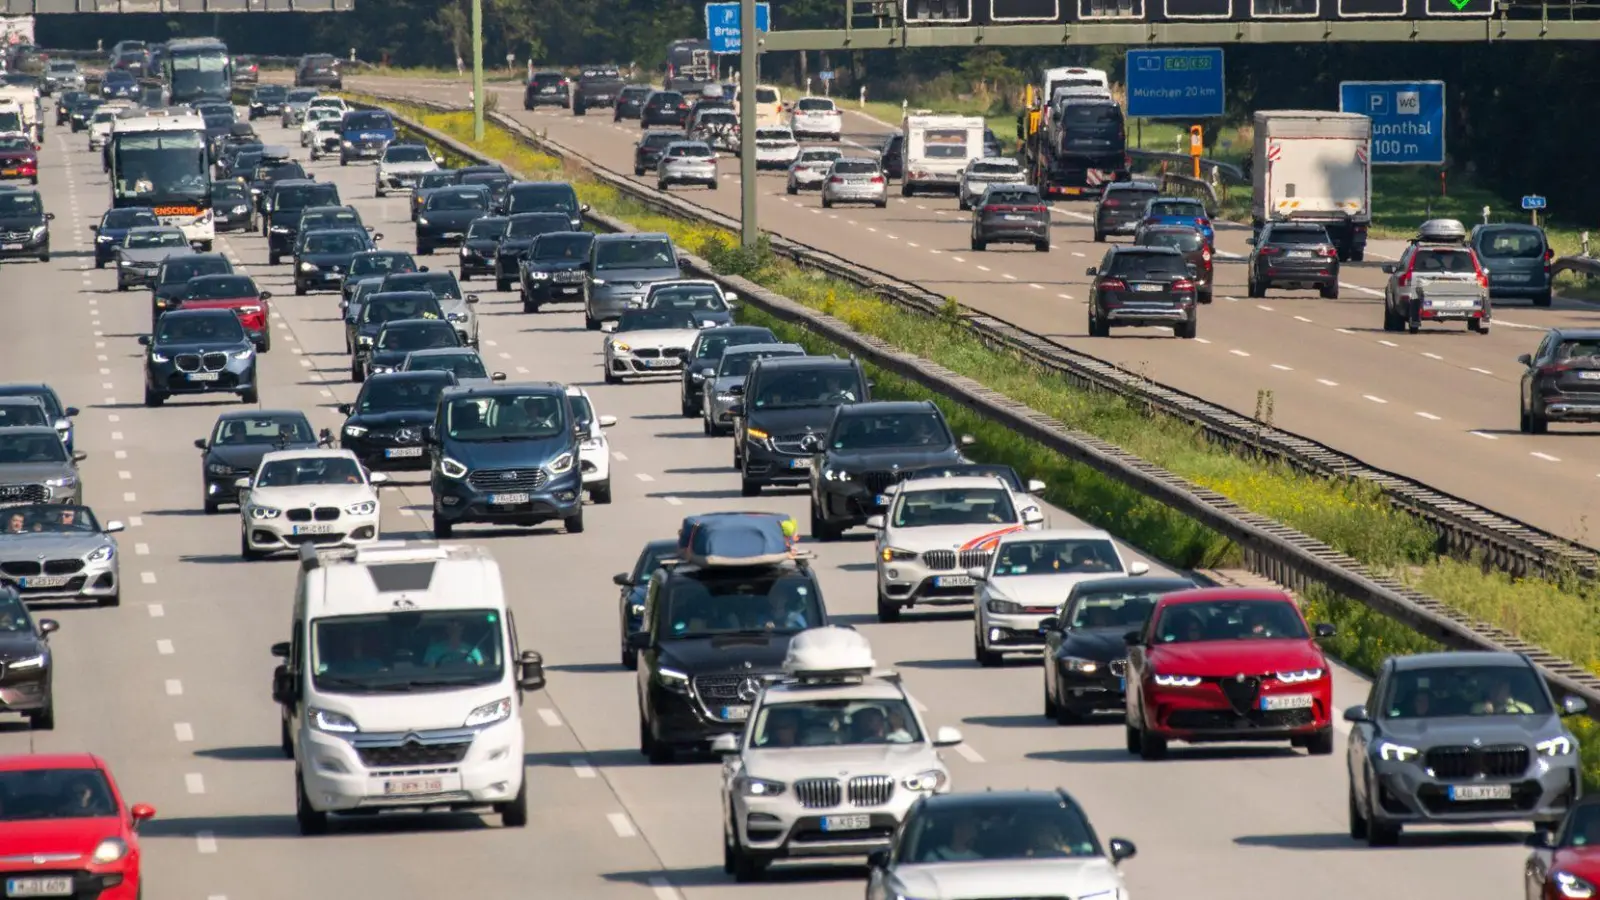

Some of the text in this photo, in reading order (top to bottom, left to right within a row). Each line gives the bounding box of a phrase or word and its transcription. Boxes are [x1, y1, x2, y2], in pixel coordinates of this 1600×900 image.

[1133, 85, 1216, 98] München 20 km
[1370, 94, 1383, 111] P
[1399, 96, 1417, 108] WC
[1374, 140, 1419, 155] 100 m
